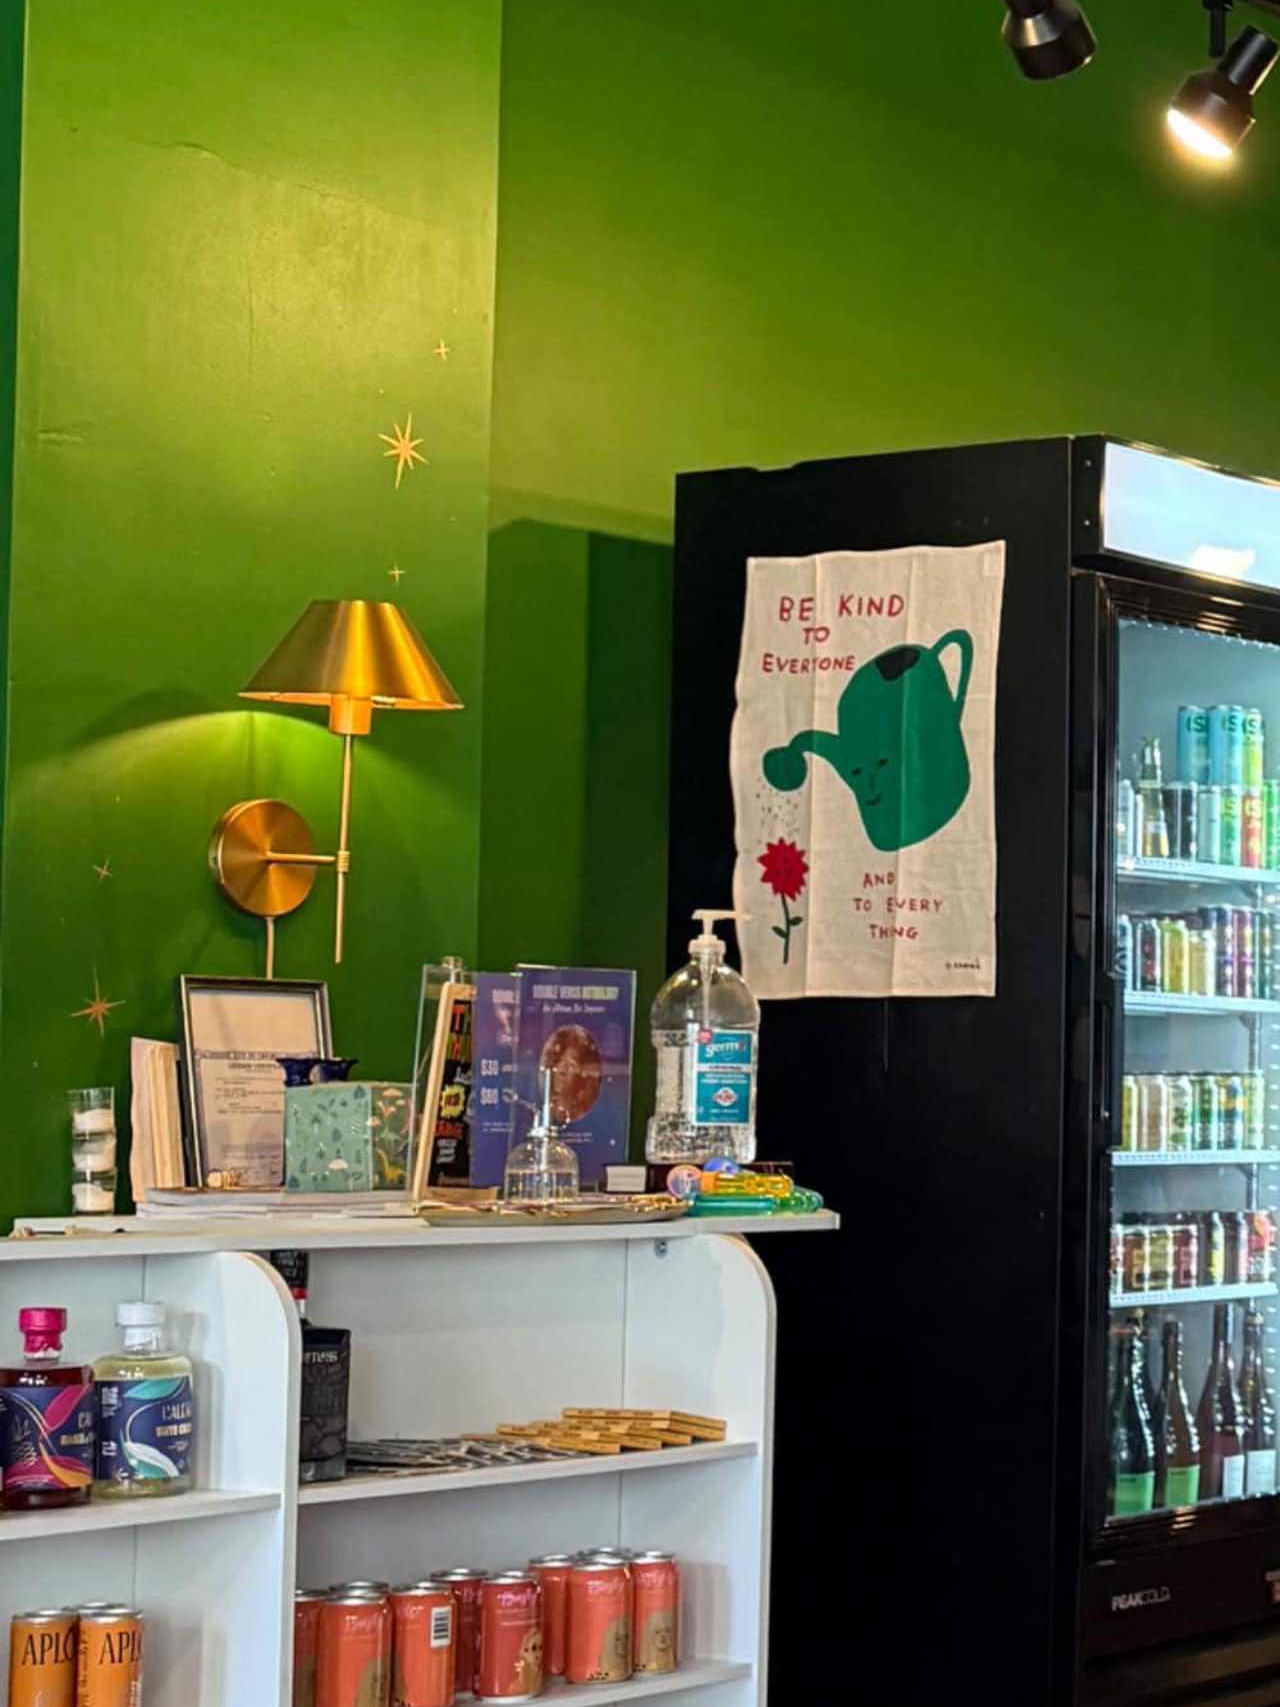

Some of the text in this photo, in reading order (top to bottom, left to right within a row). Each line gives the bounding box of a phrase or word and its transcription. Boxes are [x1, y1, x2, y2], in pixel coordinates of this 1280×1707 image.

[778, 593, 905, 622] BE KIND
[801, 625, 830, 645] TO
[761, 653, 856, 675] EVERYONE
[863, 871, 894, 889] AND
[852, 896, 943, 914] TO EVERY
[868, 923, 919, 941] THING
